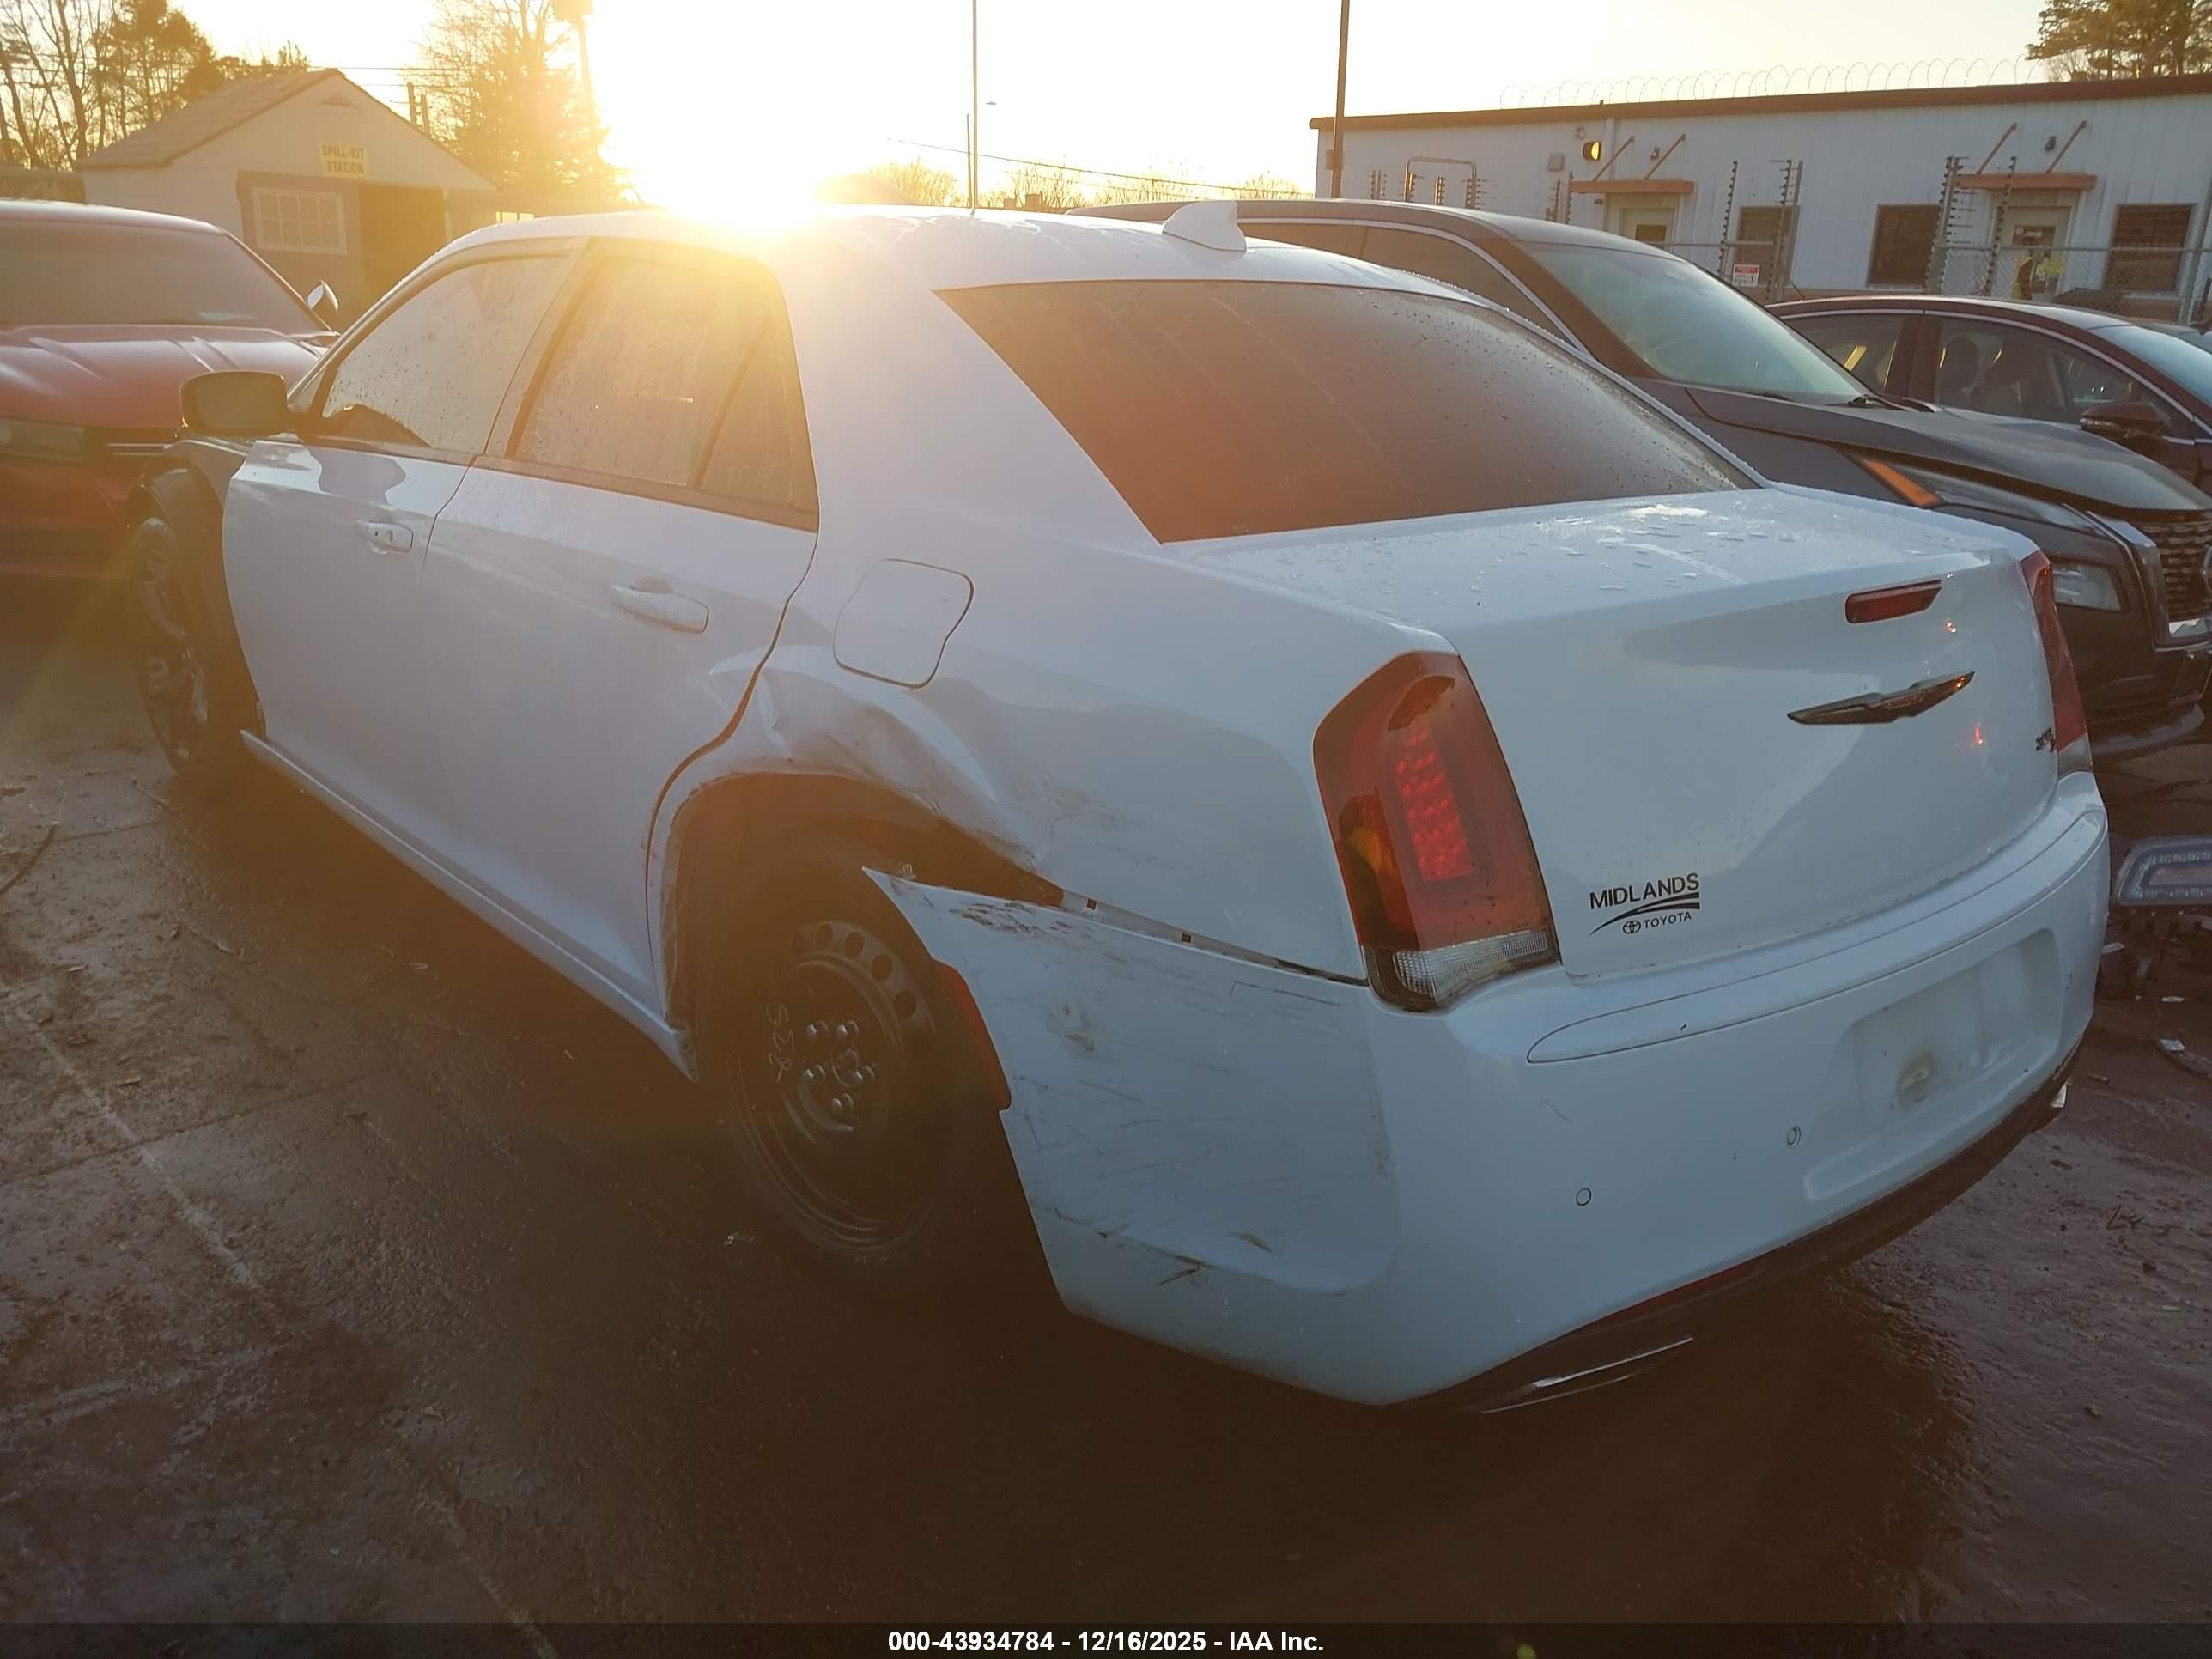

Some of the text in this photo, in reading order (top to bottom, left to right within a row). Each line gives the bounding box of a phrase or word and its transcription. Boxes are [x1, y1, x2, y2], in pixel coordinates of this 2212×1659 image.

[322, 145, 365, 159] SPILL-KIT
[325, 161, 364, 173] STATION
[1589, 872, 1700, 910] MIDLANDS
[1643, 911, 1692, 929] TOYOTA
